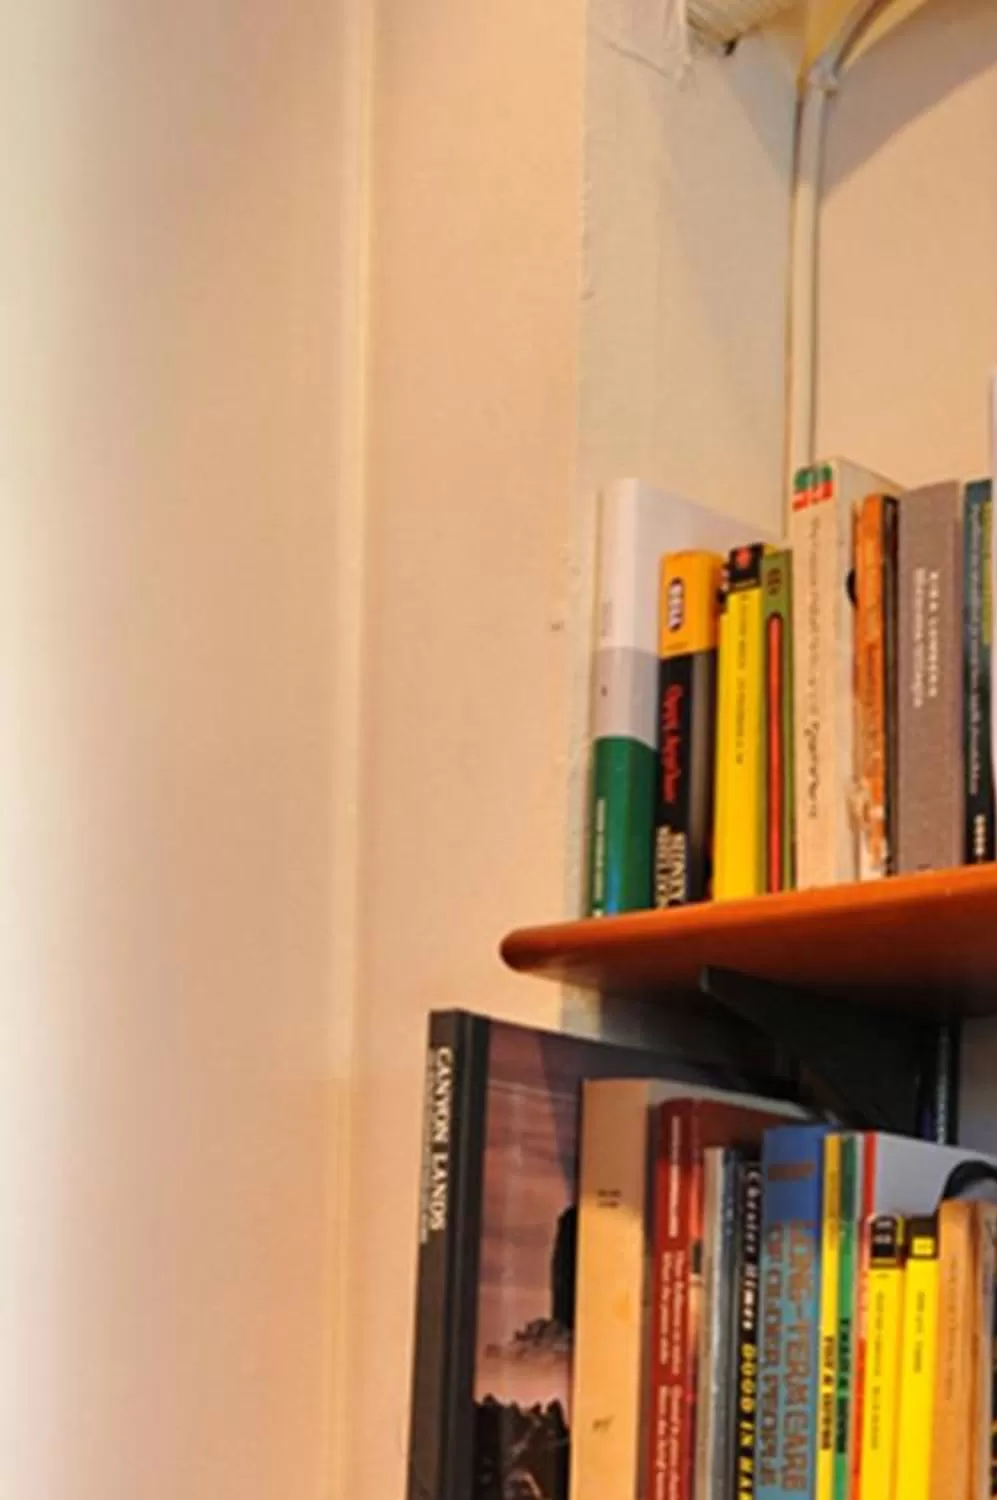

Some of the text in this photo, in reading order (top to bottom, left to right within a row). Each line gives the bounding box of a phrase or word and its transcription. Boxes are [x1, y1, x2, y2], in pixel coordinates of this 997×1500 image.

[431, 1047, 453, 1142] CANYON
[428, 1152, 448, 1231] LANDS
[741, 1263, 758, 1330] Himes
[781, 1410, 809, 1489] CARE
